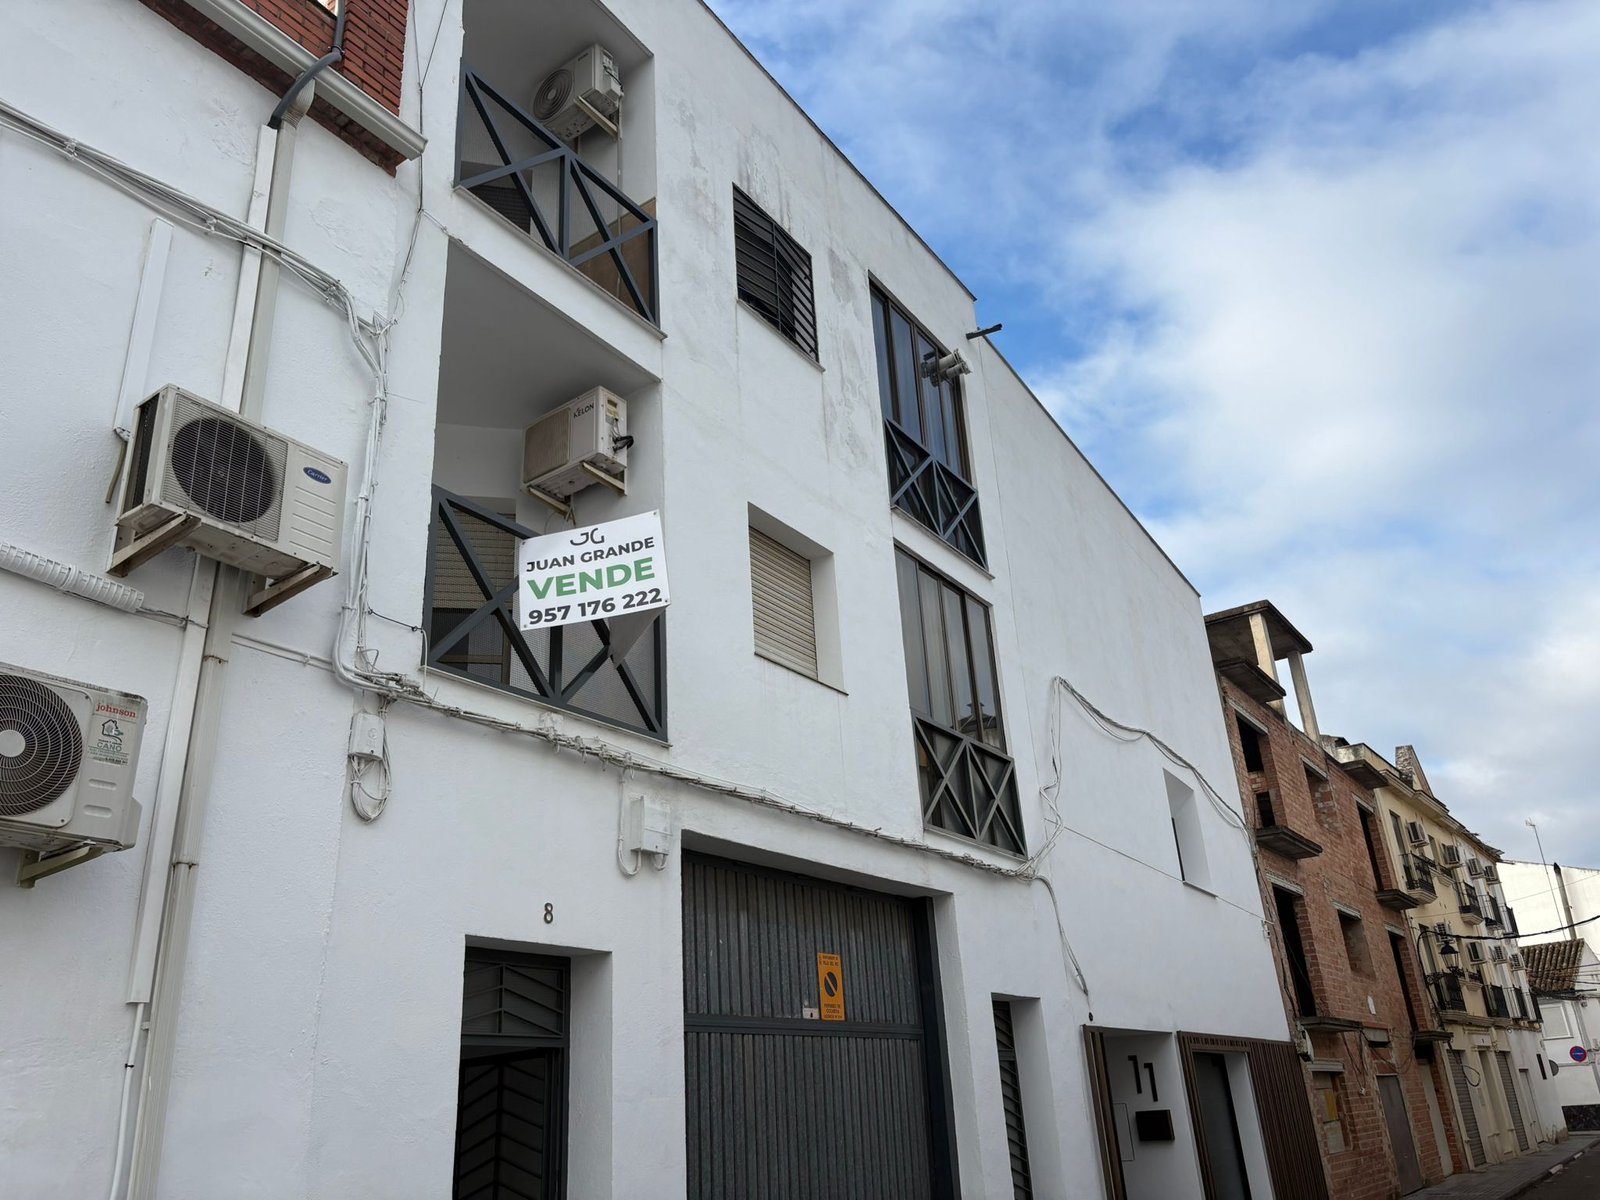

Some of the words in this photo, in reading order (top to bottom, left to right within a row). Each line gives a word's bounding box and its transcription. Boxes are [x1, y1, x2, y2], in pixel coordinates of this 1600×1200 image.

[573, 402, 595, 419] KELON
[307, 469, 328, 482] Carrier
[526, 554, 575, 572] JUAN
[580, 536, 655, 563] GRANDE
[527, 557, 656, 600] VENDE
[528, 605, 571, 625] 957
[577, 597, 616, 617] 176
[621, 587, 662, 610] 222
[95, 702, 136, 719] johnson
[543, 902, 554, 925] 8
[1127, 1055, 1159, 1102] 11
